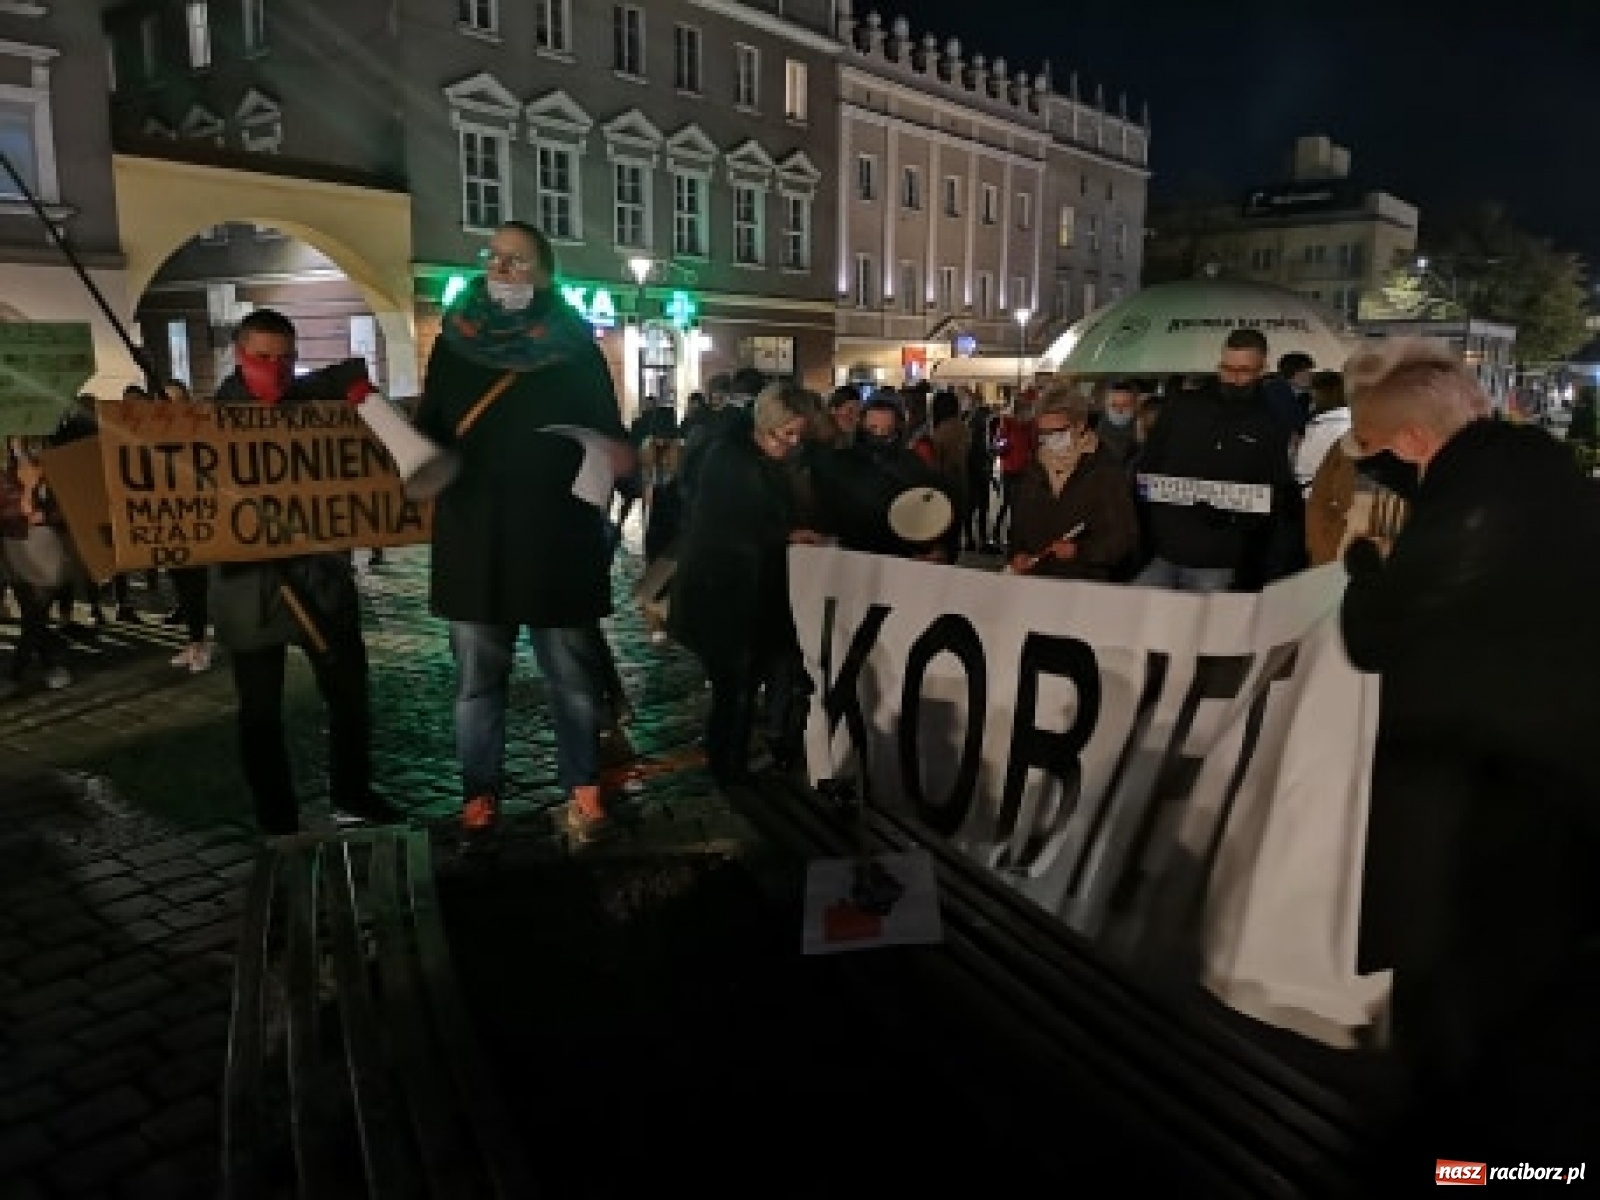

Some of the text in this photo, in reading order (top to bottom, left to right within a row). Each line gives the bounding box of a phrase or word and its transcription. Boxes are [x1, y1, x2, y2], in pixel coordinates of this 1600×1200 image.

[118, 436, 401, 492] UTRUDNIEN
[126, 496, 219, 523] MAMY
[230, 489, 423, 545] OBALENIA
[151, 547, 190, 566] DO
[818, 597, 1300, 912] KOBIET
